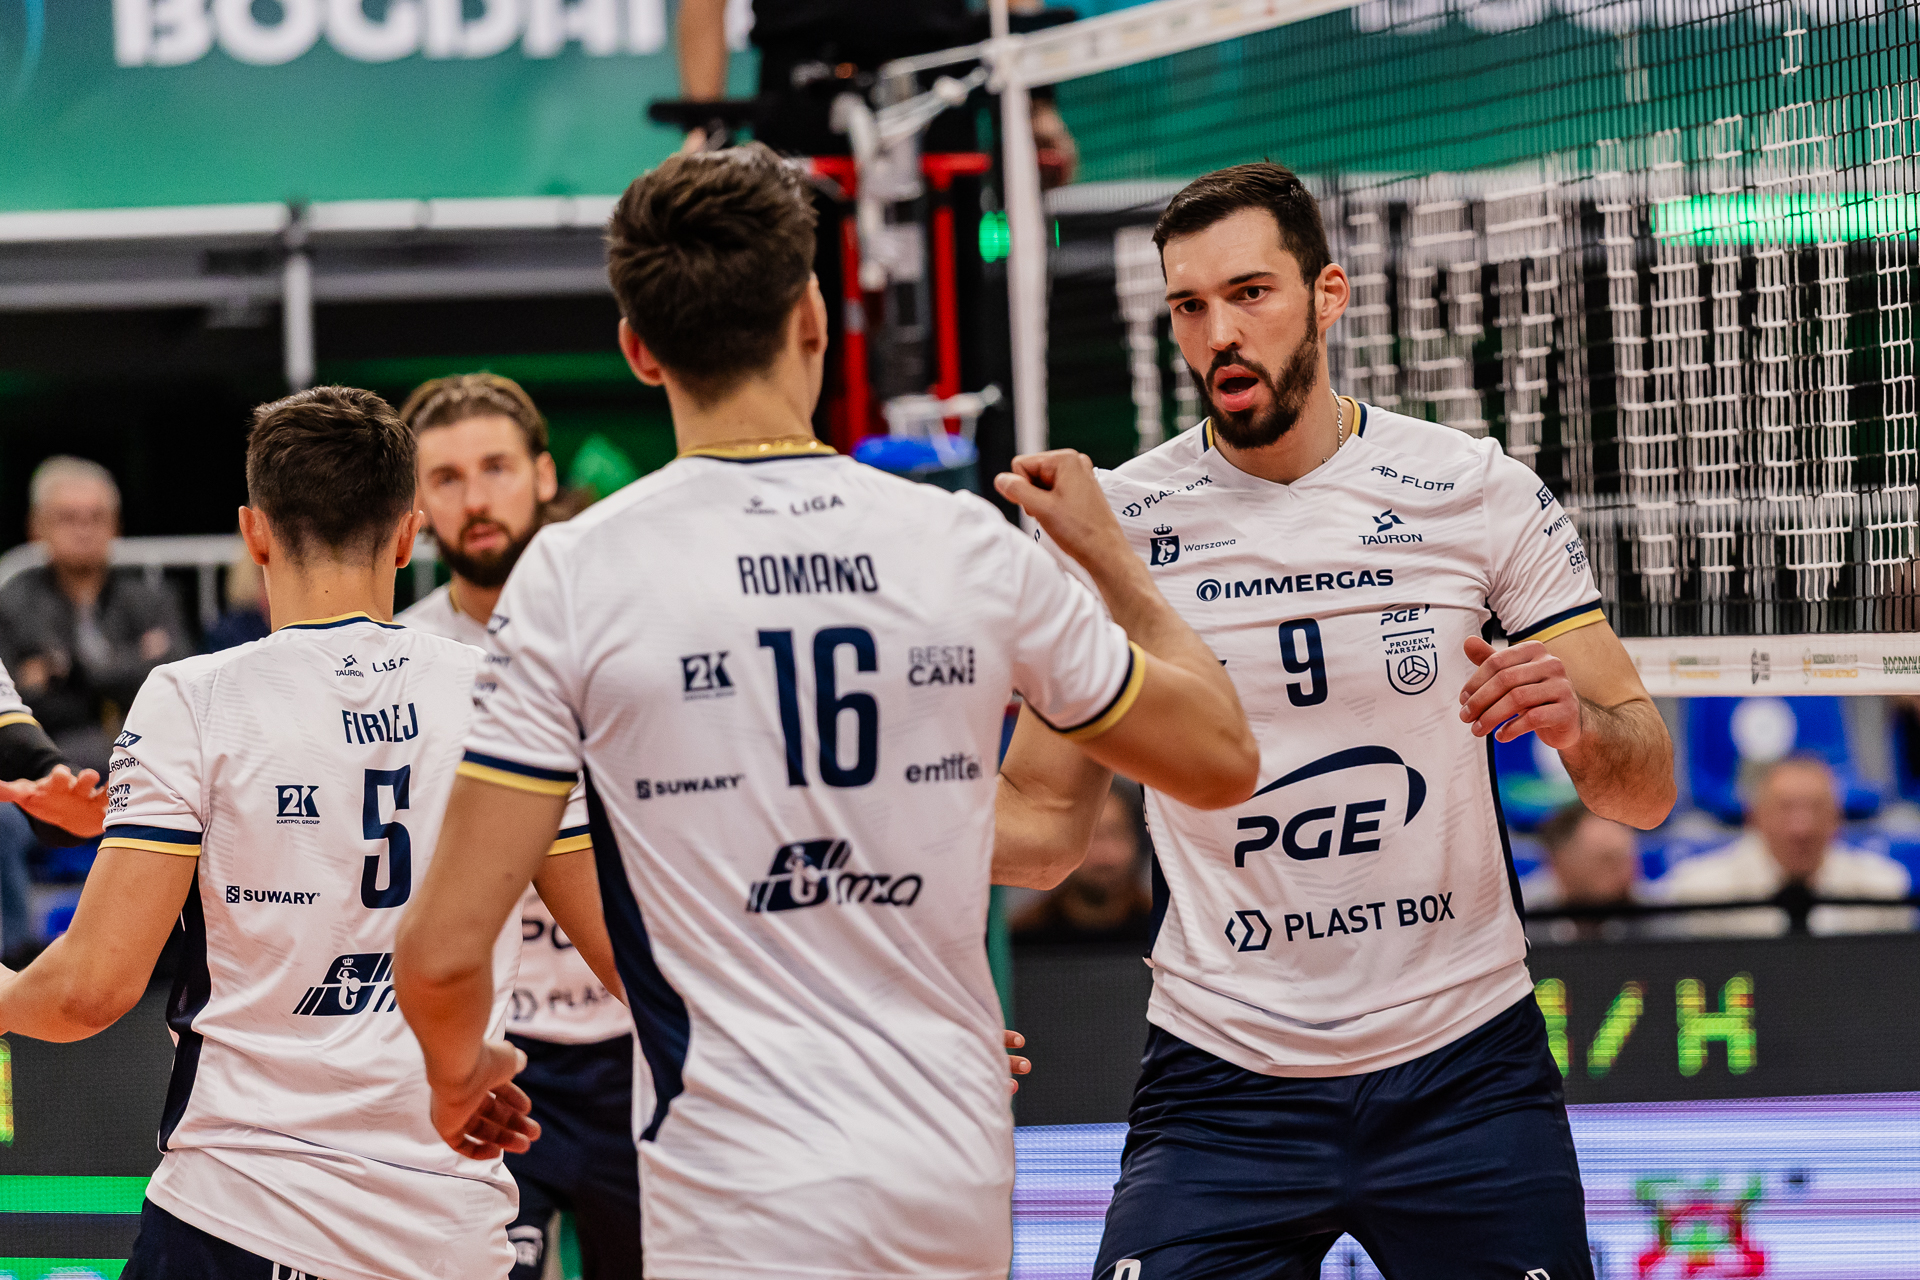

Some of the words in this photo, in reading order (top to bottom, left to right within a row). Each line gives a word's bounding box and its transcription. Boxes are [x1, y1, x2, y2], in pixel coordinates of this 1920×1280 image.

[1370, 465, 1398, 478] AP
[1401, 475, 1455, 491] FLOTA
[789, 493, 845, 516] LIGA
[1184, 537, 1237, 552] Warszawa
[1358, 533, 1424, 545] TAURON
[738, 554, 879, 595] ROMANO
[1225, 569, 1395, 599] IMMERGAS
[1380, 607, 1421, 626] PGE
[908, 646, 965, 665] BEST
[1385, 642, 1437, 656] WARSZAWA
[1389, 636, 1431, 648] PROJEKT
[335, 669, 365, 678] TAURON
[680, 650, 733, 692] 2K
[1278, 617, 1329, 707] 9
[757, 625, 880, 788] 16
[341, 702, 419, 744] FIRLEJ
[275, 785, 320, 818] 2K
[361, 764, 412, 909] 5
[1234, 798, 1387, 868] PGE
[1284, 901, 1386, 942] PLAST
[1396, 891, 1456, 927] BOX
